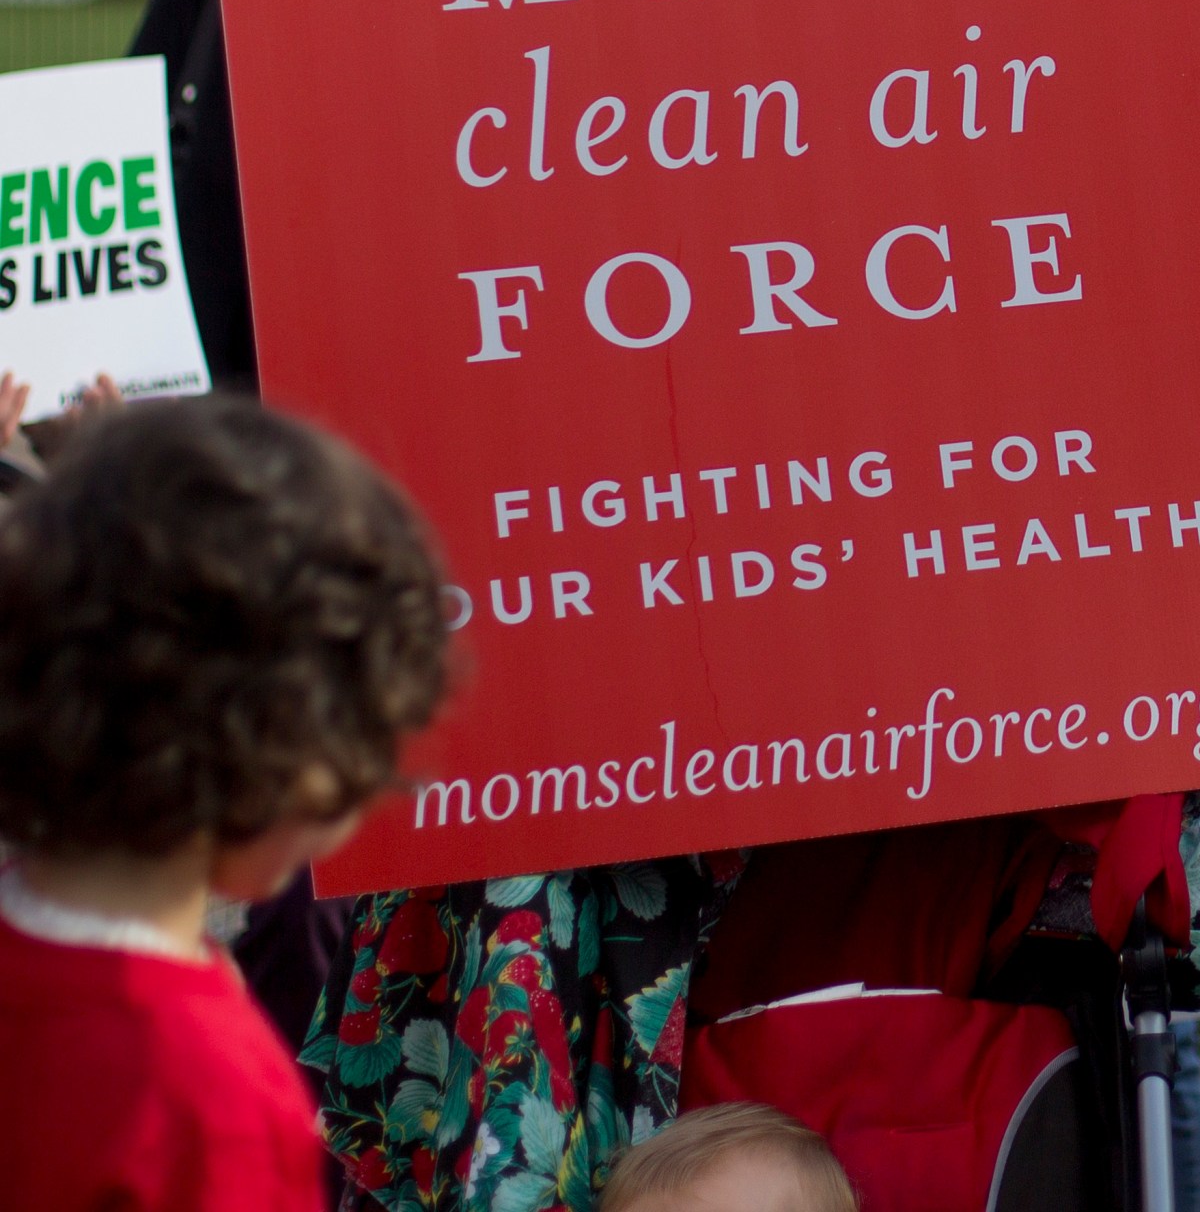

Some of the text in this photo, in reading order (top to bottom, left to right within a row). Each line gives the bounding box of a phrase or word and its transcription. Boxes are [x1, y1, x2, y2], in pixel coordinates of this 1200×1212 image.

[455, 25, 1056, 188] clean air
[0, 155, 161, 248] ENCE
[33, 239, 168, 304] LIVES
[457, 212, 1083, 363] FORCE
[494, 429, 1097, 539] FIGHTING FOR
